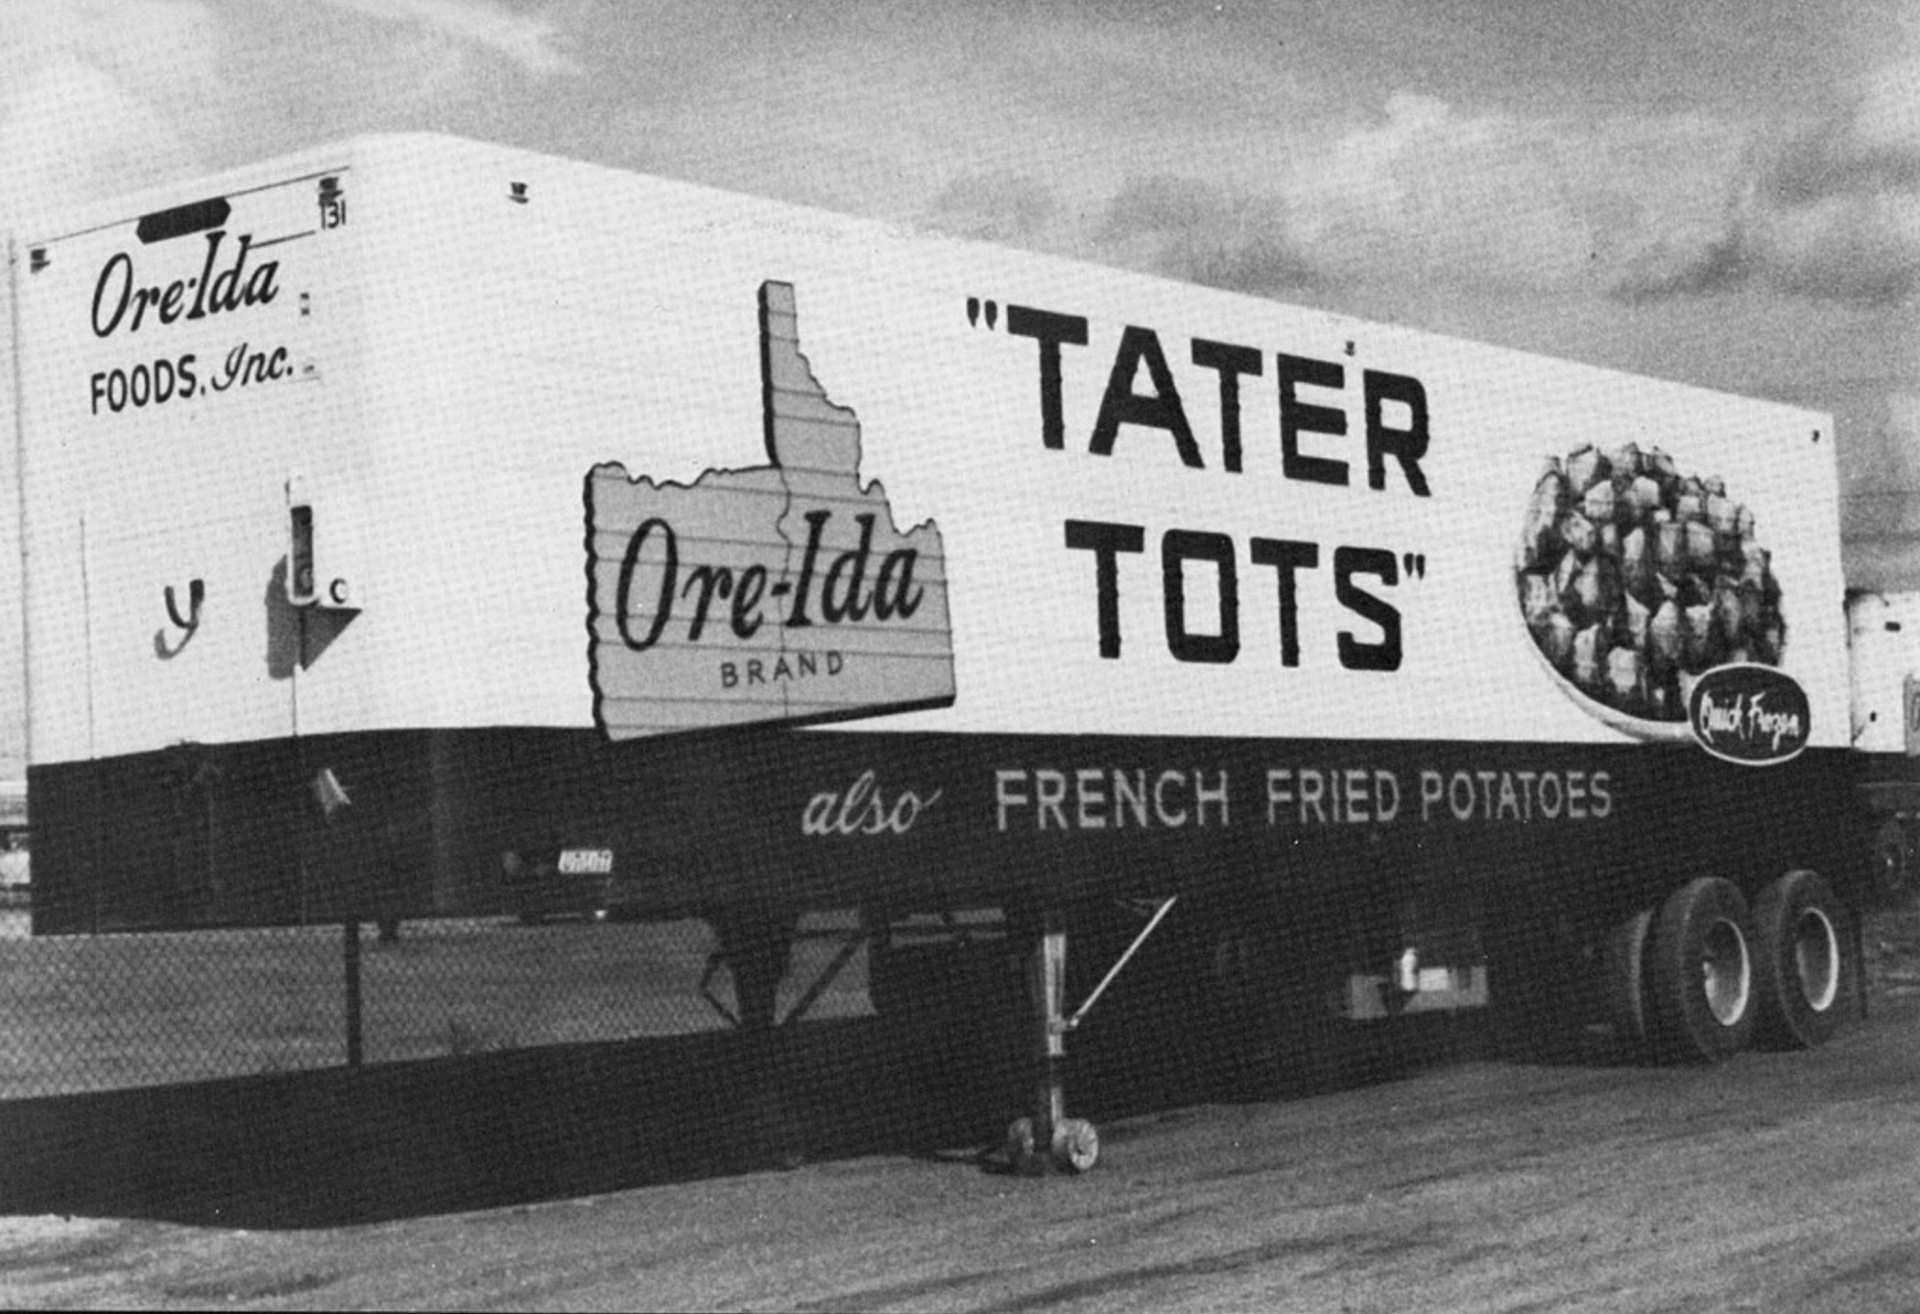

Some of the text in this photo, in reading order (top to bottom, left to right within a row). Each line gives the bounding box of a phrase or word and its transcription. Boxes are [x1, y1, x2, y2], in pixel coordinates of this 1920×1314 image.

[210, 341, 294, 392] Inc.
[615, 509, 925, 652] Ore-Ida
[720, 650, 845, 688] BRAND
[801, 768, 1613, 836] also FRENCH FRIED POTATOES
